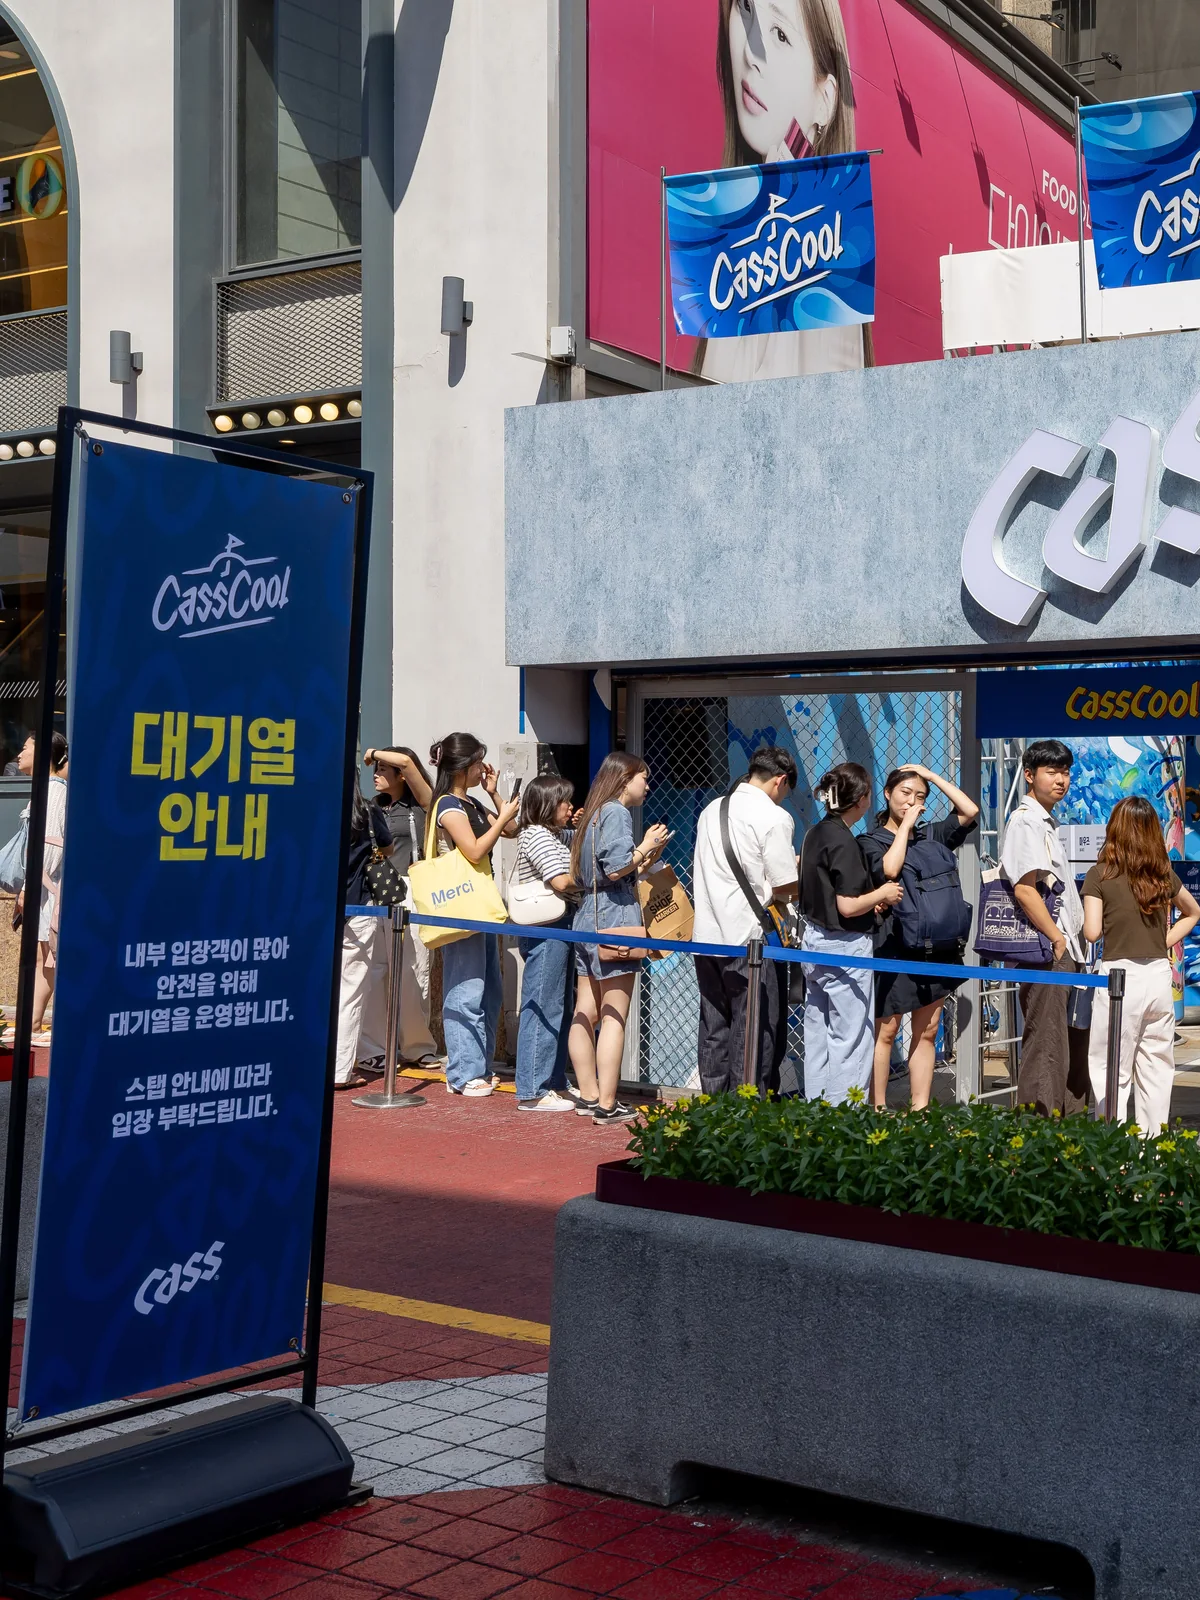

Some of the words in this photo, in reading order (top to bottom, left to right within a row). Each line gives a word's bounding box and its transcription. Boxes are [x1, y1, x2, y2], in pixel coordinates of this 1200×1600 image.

[1065, 680, 1200, 721] CassCool
[130, 711, 296, 786] 대기열
[158, 791, 269, 862] 안내
[431, 879, 474, 905] Merci
[650, 893, 675, 914] SHOE
[655, 903, 679, 922] MARKER
[124, 942, 166, 968] 내부
[171, 938, 249, 966] 입장객이
[253, 936, 290, 960] 많아
[156, 972, 216, 1000] 안전을
[220, 969, 259, 996] 위해
[108, 1006, 191, 1036] 대기열을
[195, 998, 295, 1030] 운영합니다.
[124, 1074, 167, 1101] 스탭
[171, 1067, 231, 1097] 안내에
[234, 1062, 273, 1089] 따라
[111, 1108, 154, 1138] 입장
[158, 1093, 279, 1131] 부탁드립니다.
